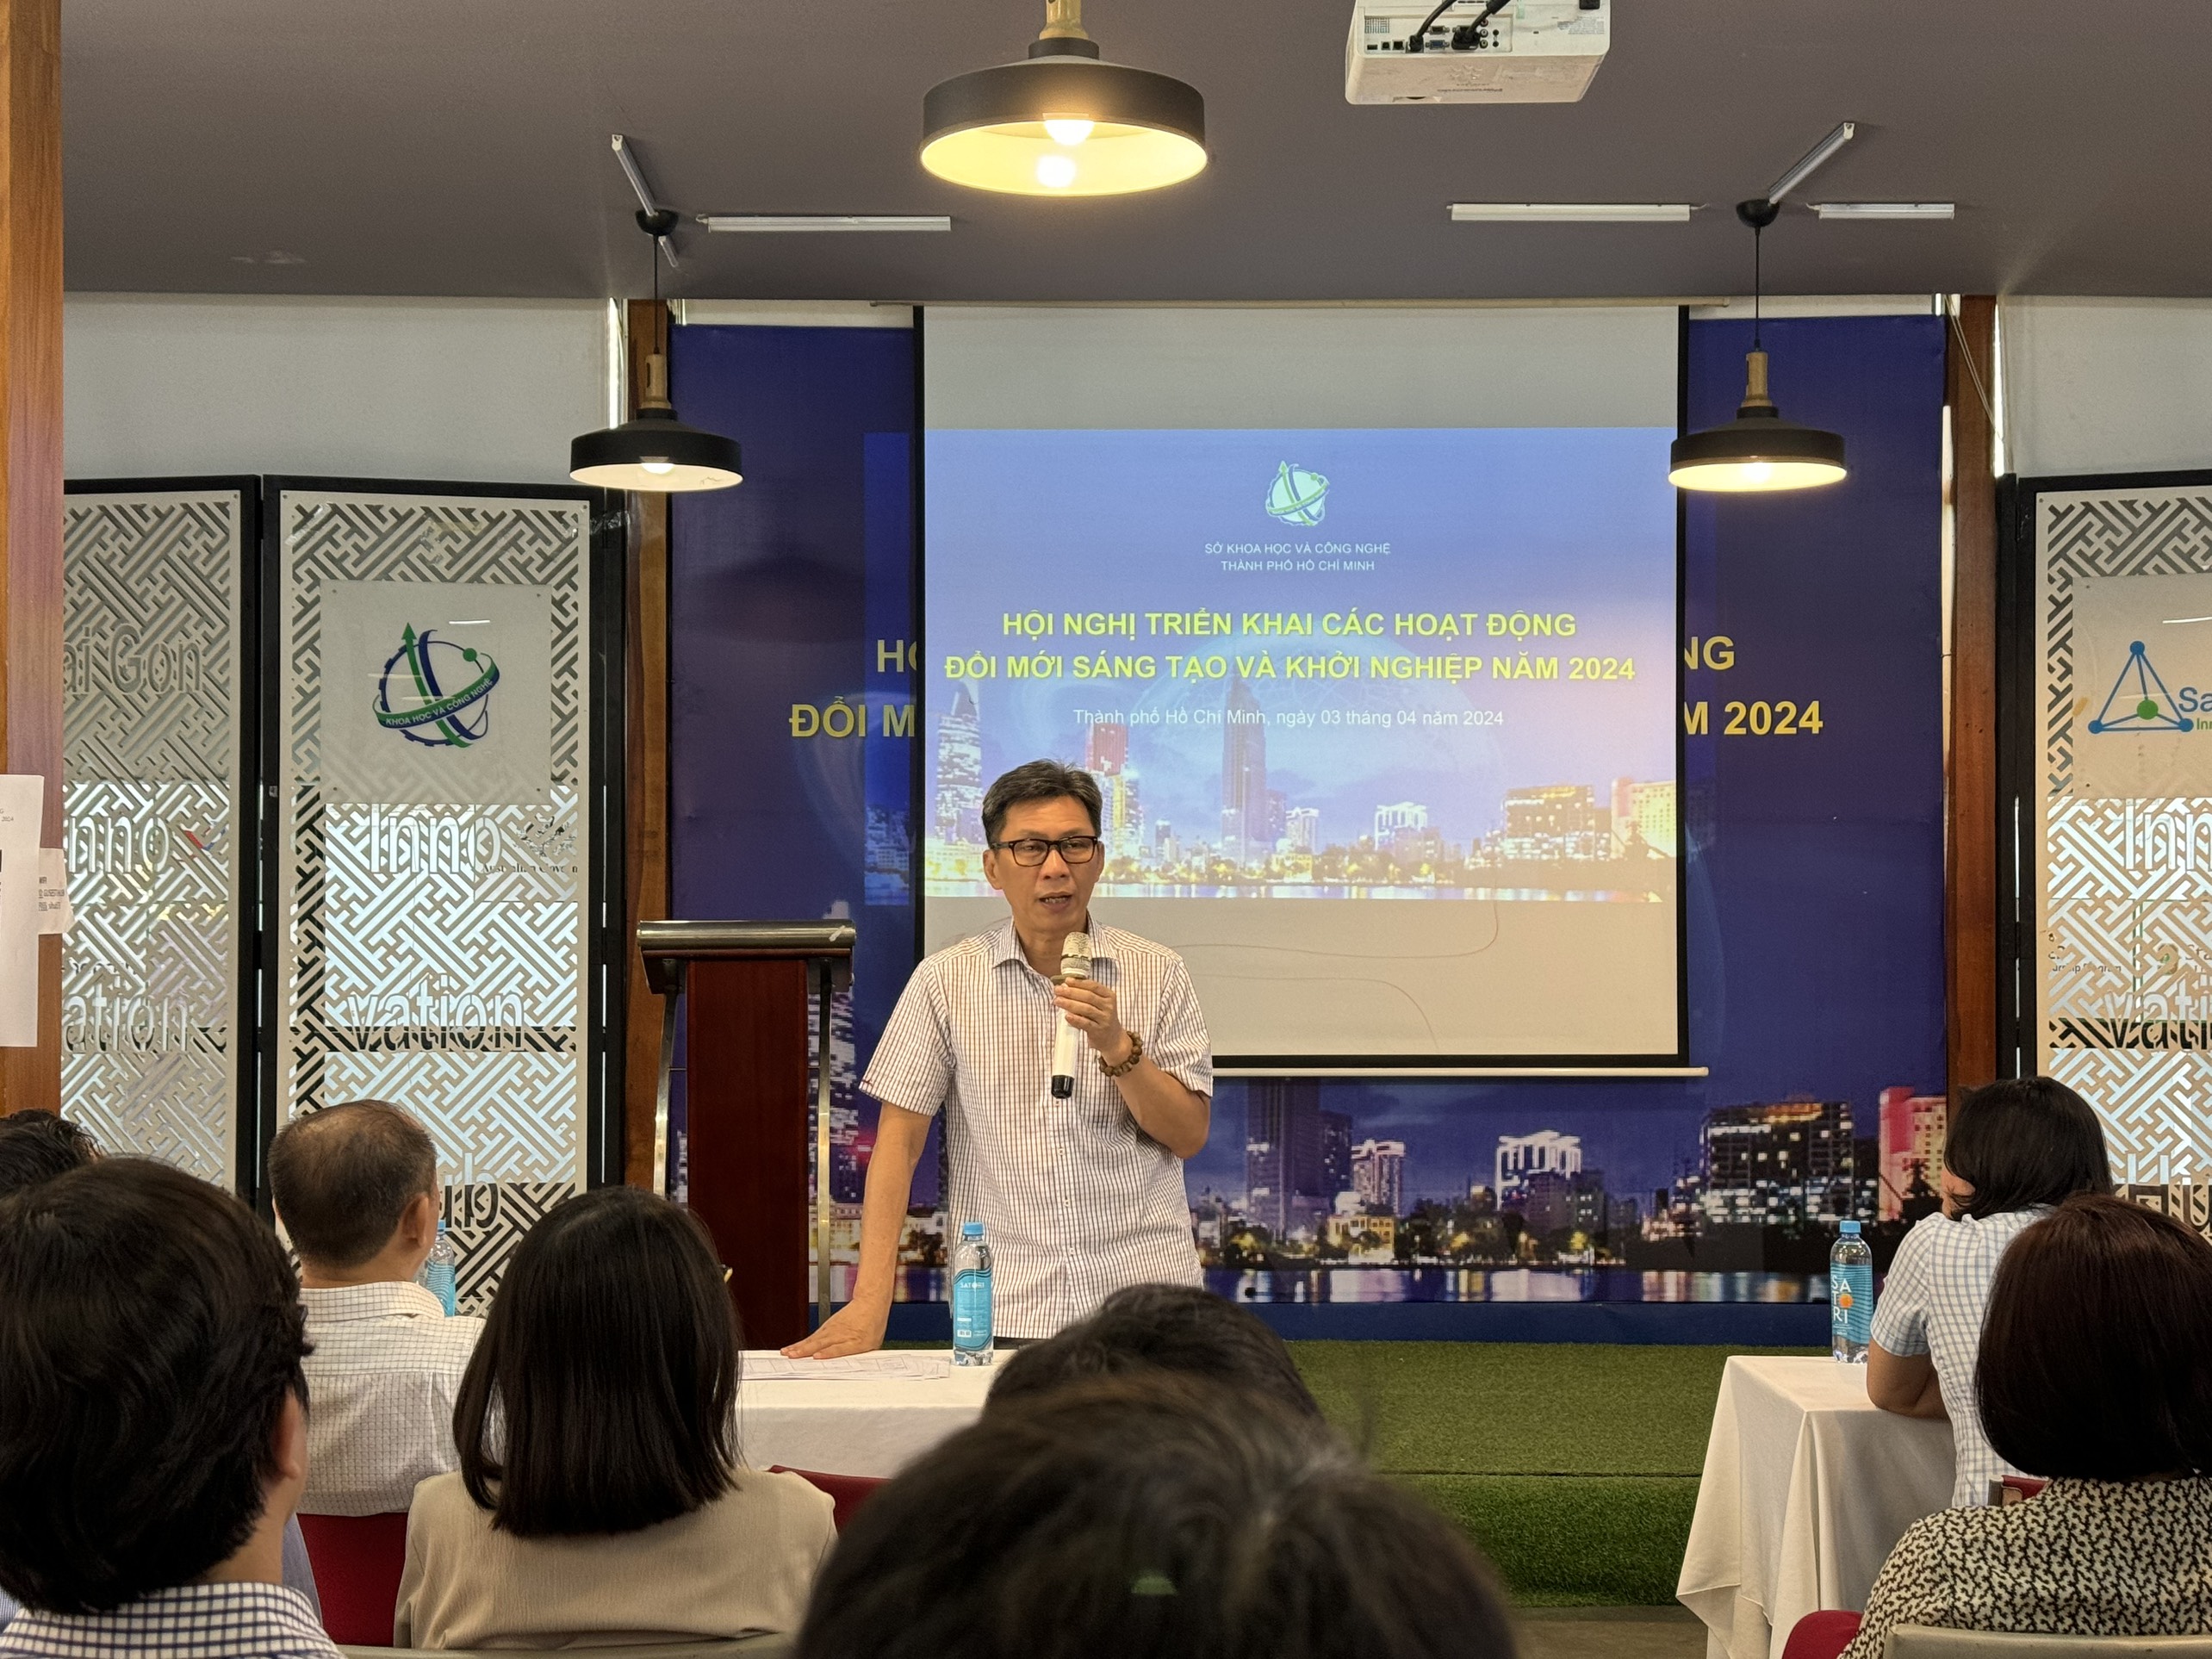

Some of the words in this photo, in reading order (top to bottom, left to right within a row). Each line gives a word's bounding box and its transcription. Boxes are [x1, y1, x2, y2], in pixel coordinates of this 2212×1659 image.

[1221, 558, 1263, 571] THÀNH
[1344, 561, 1375, 571] MINH
[1227, 543, 1262, 554] KHOA
[1264, 543, 1291, 556] HỌC
[1295, 541, 1311, 554] VÀ
[1314, 541, 1351, 554] CÔNG
[1355, 542, 1391, 556] NGHỆ
[1003, 609, 1053, 640] HỘI
[1064, 612, 1135, 641] NGHỊ
[1145, 607, 1232, 636] TRIỂN
[1242, 612, 1313, 636] KHAI
[1321, 607, 1384, 637] CÁC
[1395, 612, 1478, 642] HOẠT
[1486, 610, 1577, 642] ĐỘNG
[945, 650, 996, 679] ĐỔI
[1006, 650, 1062, 679] MỚI
[1072, 650, 1156, 679] SÁNG
[1165, 656, 1227, 684] TẠO
[1236, 650, 1277, 679] VÀ
[1286, 651, 1360, 680] KHỞI
[1370, 653, 1483, 684] NGHIỆP
[1492, 651, 1559, 680] NĂM
[1568, 657, 1636, 680] 2024
[385, 716, 412, 726] KHOA
[788, 695, 867, 738] ĐỔI
[1073, 709, 1124, 724] Thành
[1130, 706, 1159, 727] phố
[1165, 706, 1188, 724] Hồ
[1193, 709, 1221, 724] Chí
[1227, 709, 1271, 726] Minh,
[1277, 709, 1315, 728] ngày
[1320, 710, 1341, 724] 03
[1345, 710, 1391, 728] tháng
[1397, 710, 1417, 725] 04
[1422, 711, 1458, 725] năm
[1463, 711, 1504, 725] 2024
[1724, 699, 1824, 736] 2024
[370, 803, 502, 874] Inno
[346, 974, 524, 1051] vation
